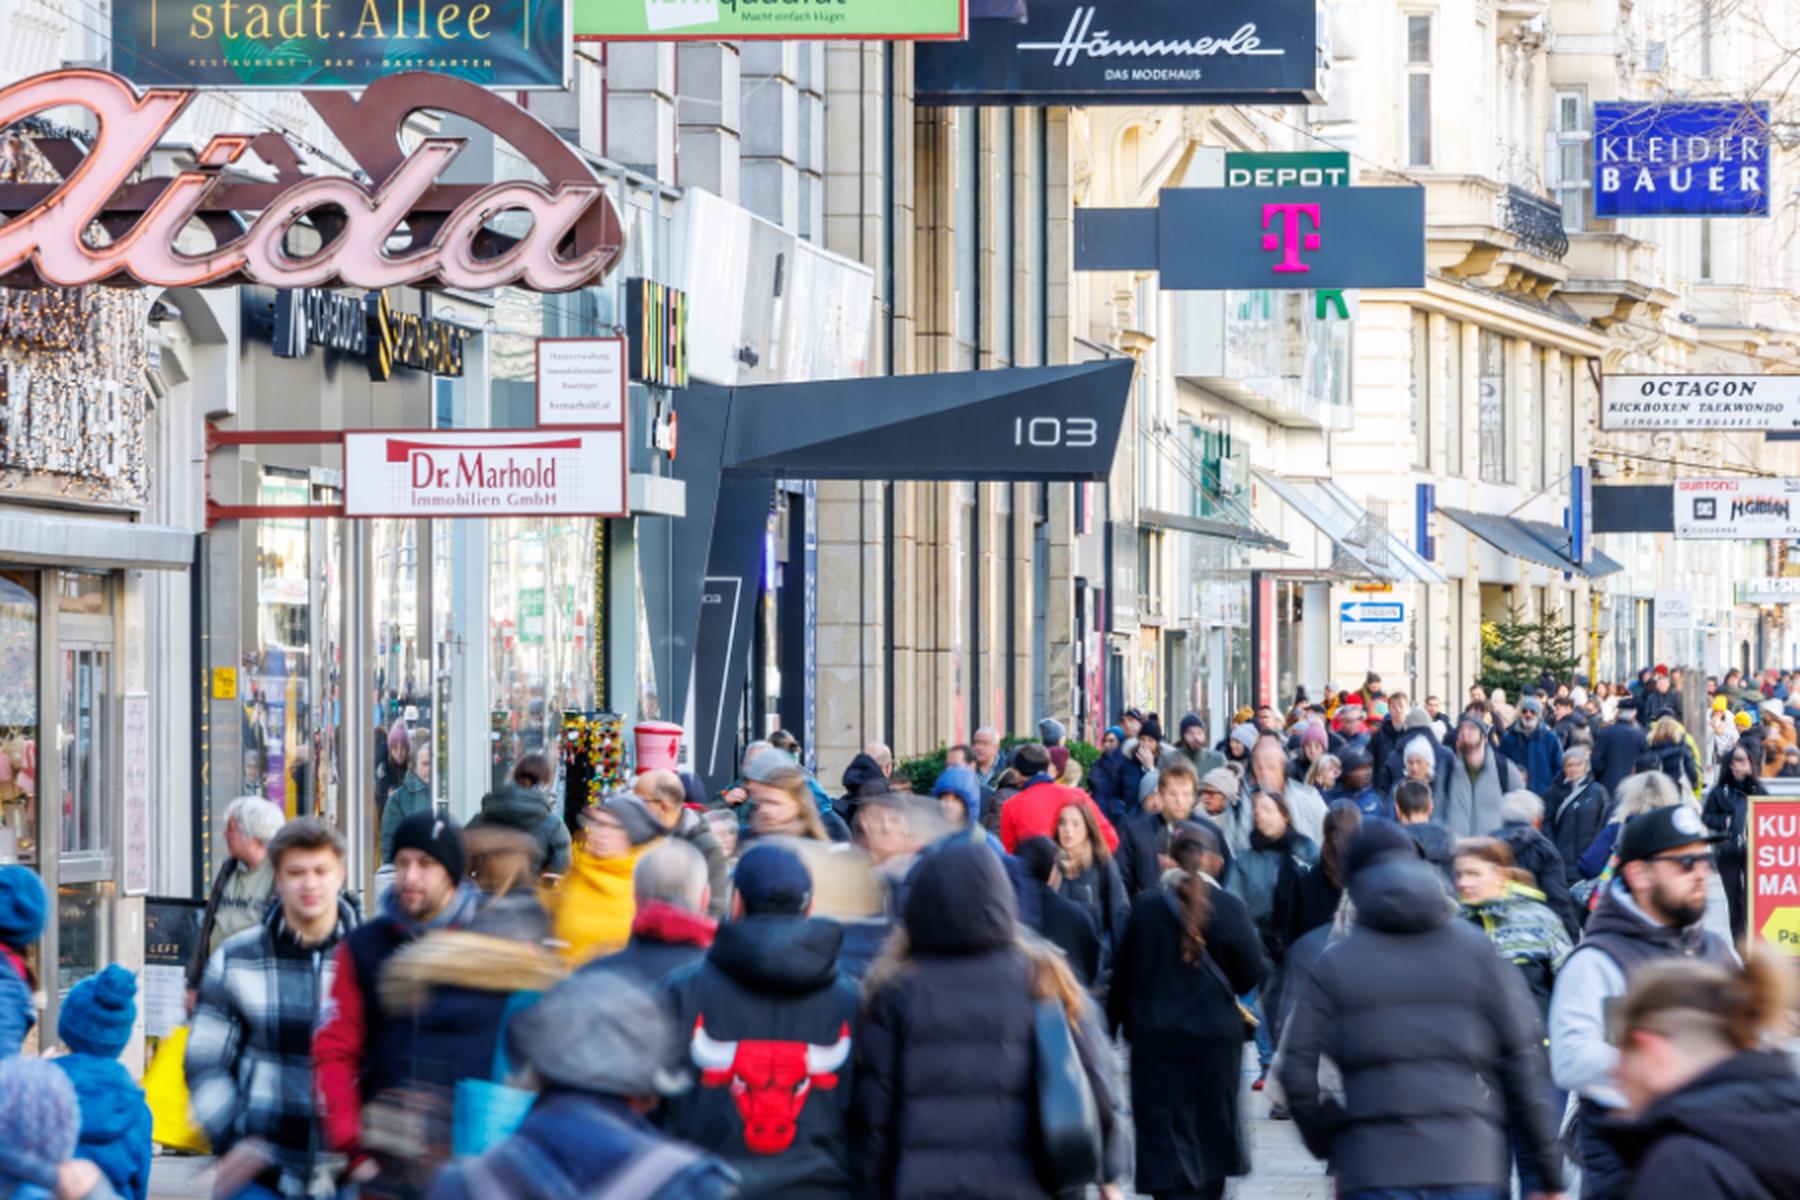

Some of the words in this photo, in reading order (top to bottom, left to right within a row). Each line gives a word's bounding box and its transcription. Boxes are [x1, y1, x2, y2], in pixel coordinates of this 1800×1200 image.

[189, 0, 493, 39] stadt.Allee
[741, 12, 773, 22] Macht
[775, 11, 812, 22] einfach
[1104, 69, 1129, 81] DAS
[1132, 69, 1202, 81] MODEHAUS
[1602, 136, 1761, 163] KLEIDER
[1229, 168, 1346, 187] DEPOT
[1602, 167, 1762, 193] BAUER
[1262, 203, 1321, 272] T
[1640, 381, 1757, 397] OCTAGON
[1609, 403, 1690, 413] KICKBOXEN
[1699, 403, 1784, 413] TAEKWONDO
[1015, 417, 1098, 447] 103
[411, 452, 450, 489] Dr.
[455, 452, 557, 489] Marhold
[411, 491, 501, 507] Immobilien
[507, 493, 557, 507] GmbH
[1758, 815, 1800, 838] KU
[1758, 845, 1800, 868] SU
[1758, 874, 1800, 896] MA
[1778, 929, 1800, 945] Pa
